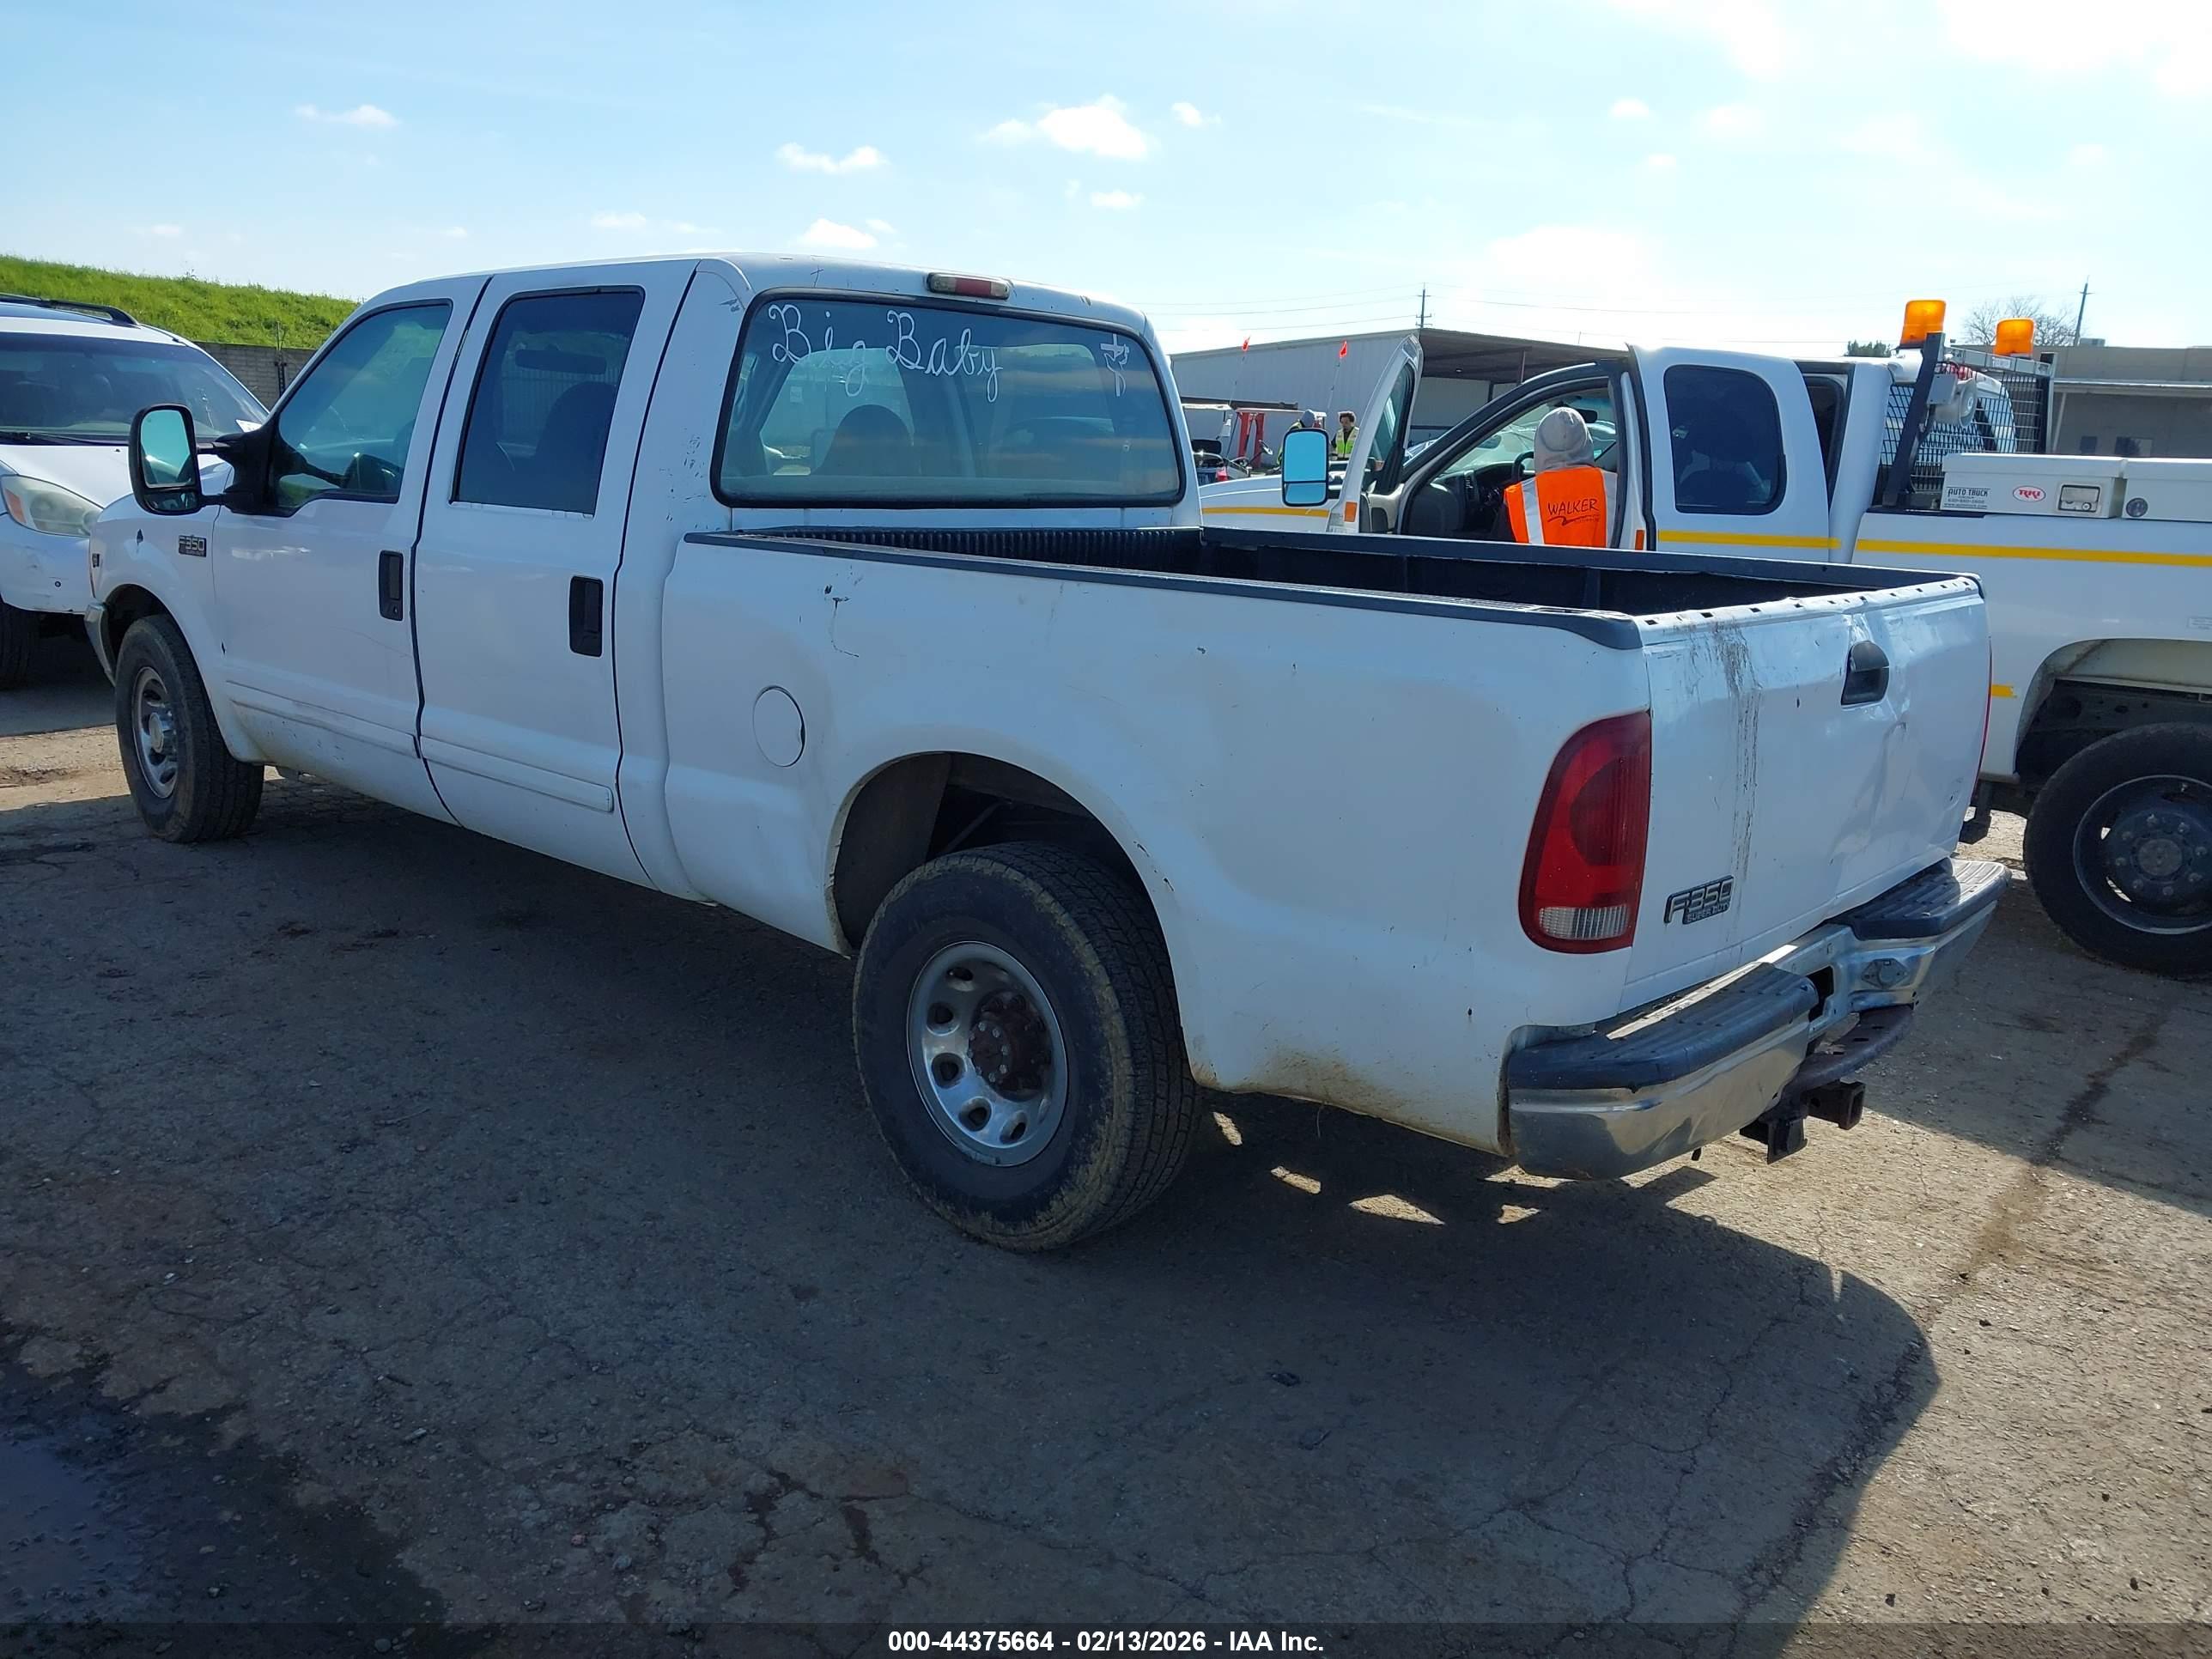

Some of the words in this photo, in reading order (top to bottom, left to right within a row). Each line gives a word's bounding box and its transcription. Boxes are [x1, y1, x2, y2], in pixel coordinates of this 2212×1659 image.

[768, 304, 869, 398] Big
[885, 309, 1004, 403] Baby
[1547, 498, 1600, 515] WALKER
[1948, 488, 1966, 497] AUTO
[1968, 489, 1988, 498] TRUCK
[1666, 877, 1734, 922] F350
